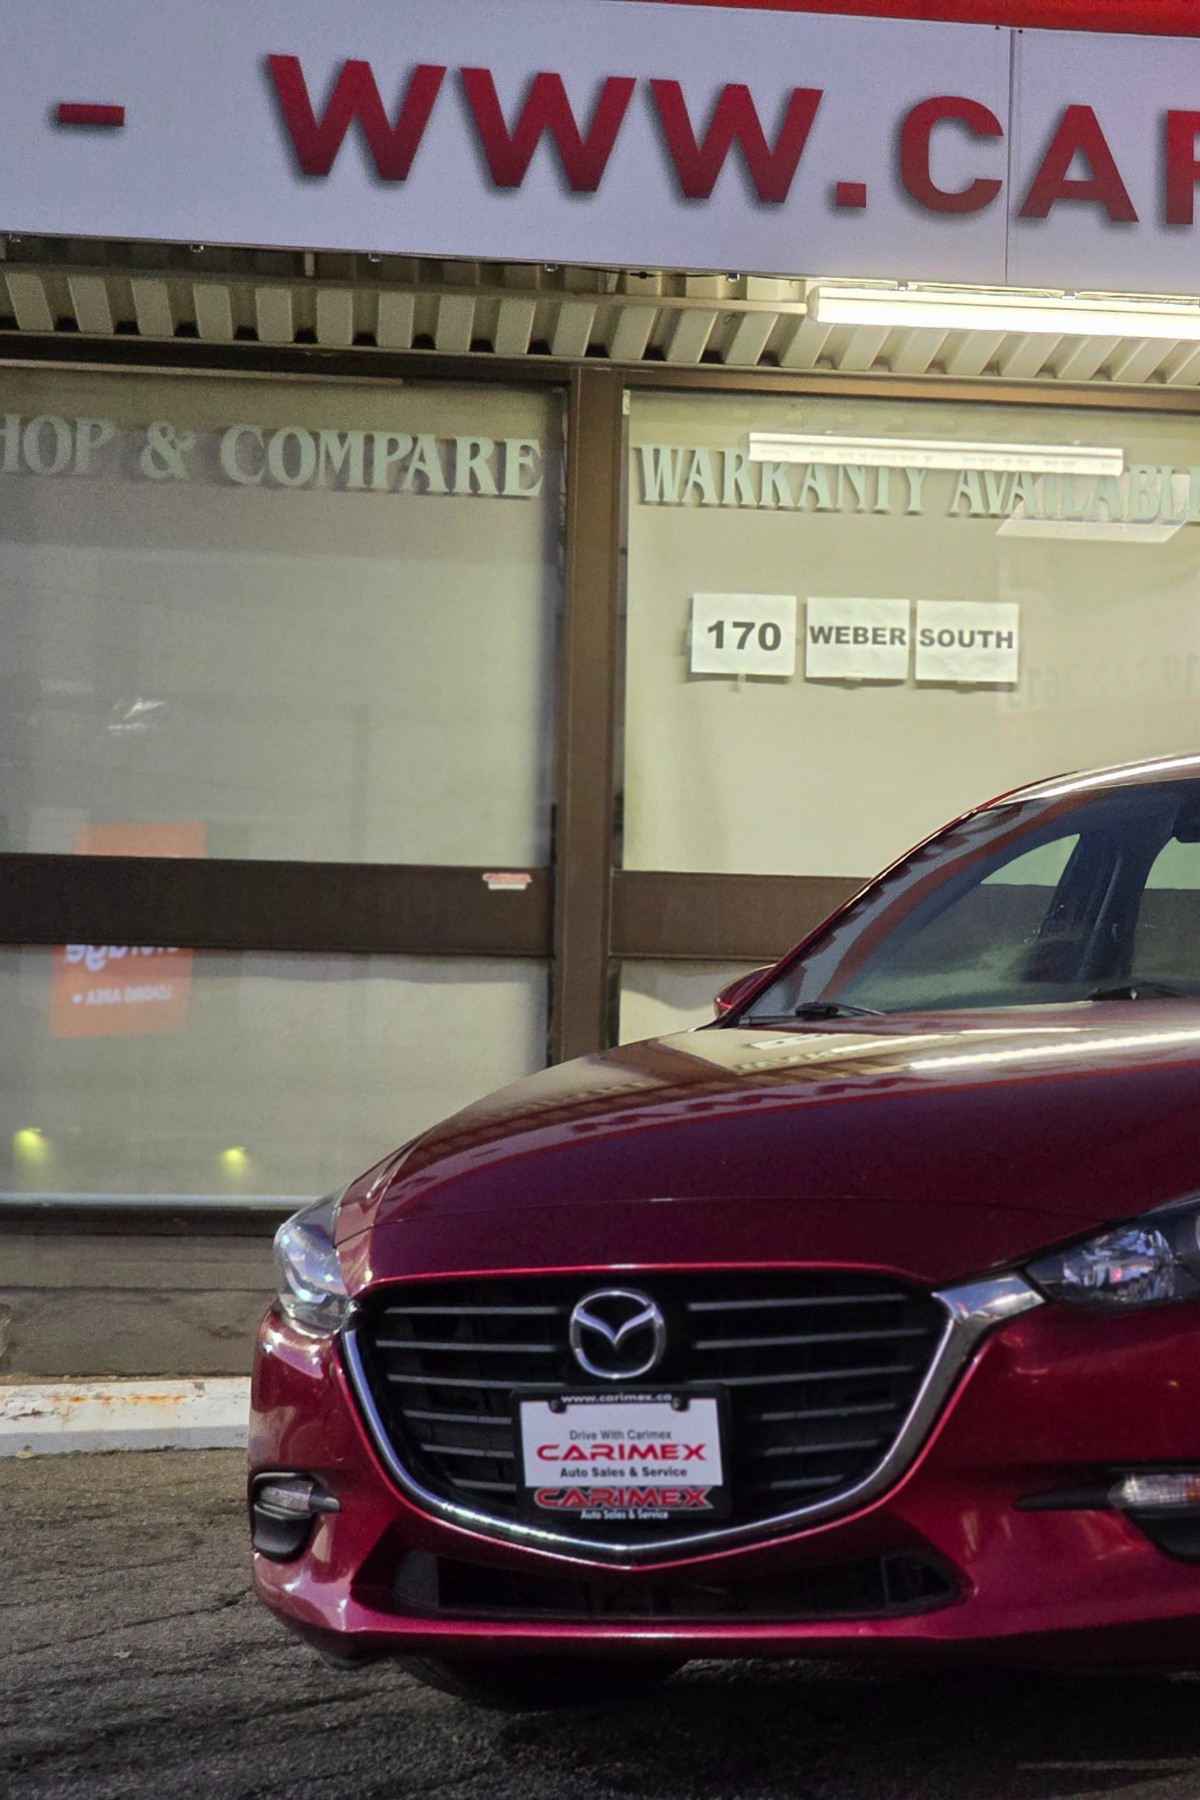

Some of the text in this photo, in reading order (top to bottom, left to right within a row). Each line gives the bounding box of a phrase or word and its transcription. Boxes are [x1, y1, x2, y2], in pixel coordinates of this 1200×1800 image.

[140, 417, 196, 480] &
[220, 423, 544, 498] COMPARE
[706, 619, 782, 651] 170
[808, 625, 907, 646] WEBER
[918, 628, 1014, 649] SOUTH
[561, 1392, 673, 1403] www.carimex.ca
[570, 1428, 672, 1441] Drive With Carimex
[536, 1444, 707, 1461] CARIMEX
[560, 1466, 687, 1478] Auto Sales & Service
[535, 1487, 712, 1508] CARIMEX
[580, 1509, 669, 1520] Auto Sales & Service
